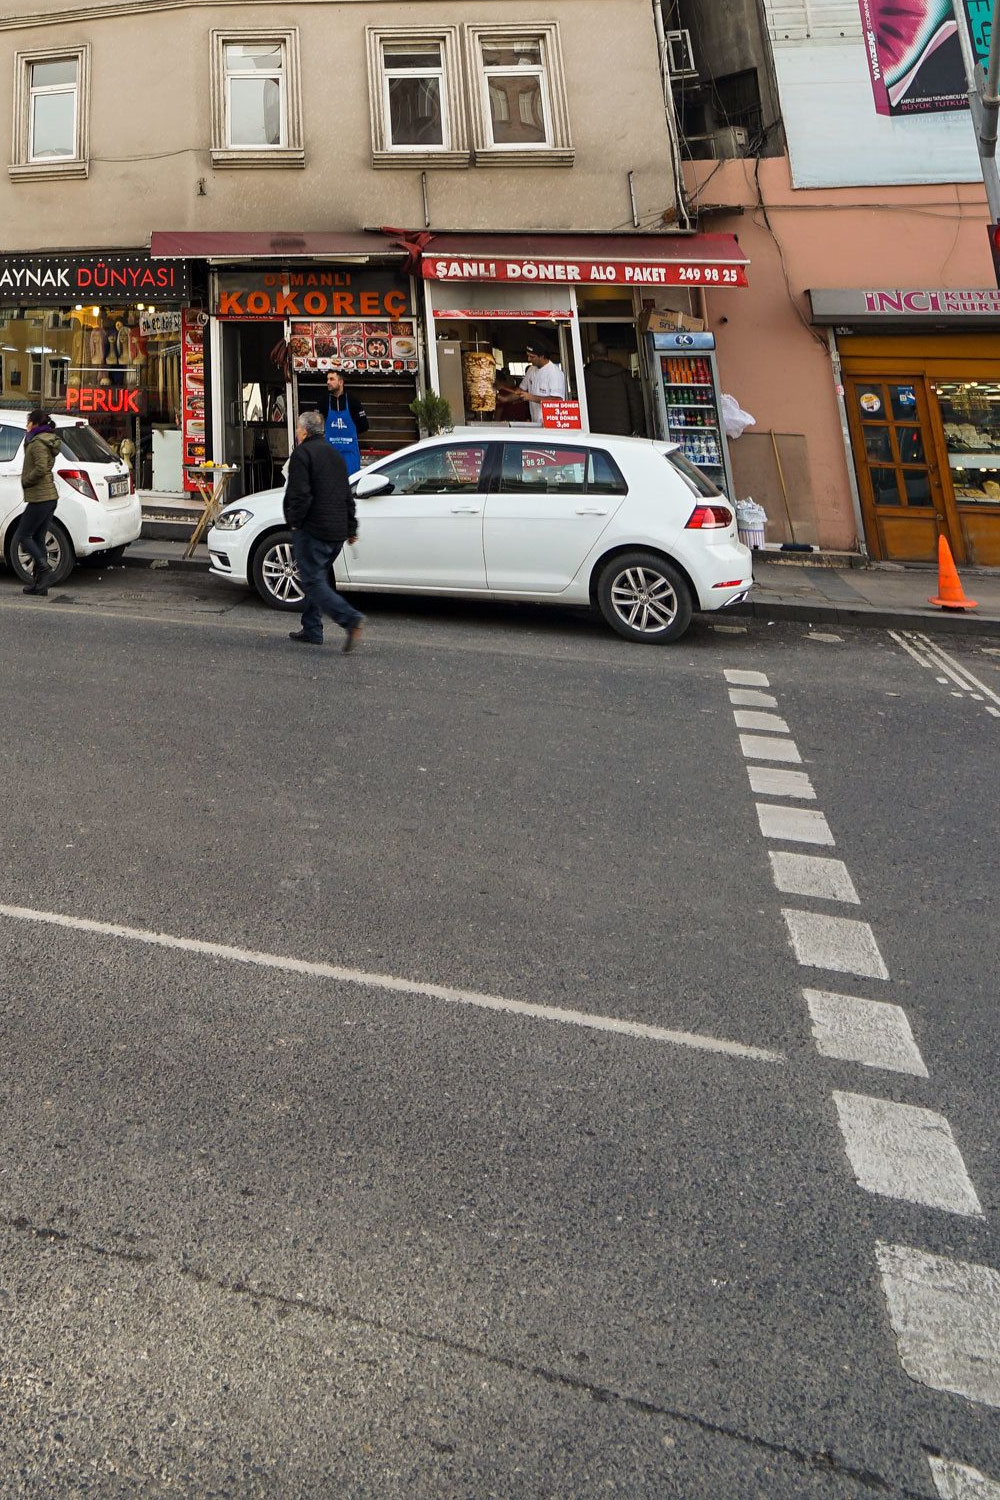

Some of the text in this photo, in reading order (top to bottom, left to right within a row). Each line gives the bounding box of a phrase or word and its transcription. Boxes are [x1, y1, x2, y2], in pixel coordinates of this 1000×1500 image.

[77, 263, 175, 288] DÜNYASI
[435, 260, 738, 283] ŞANLI DÖNER ALO PAKET 249 98 25
[219, 291, 407, 322] KOKOREÇ
[66, 388, 140, 413] PERUK
